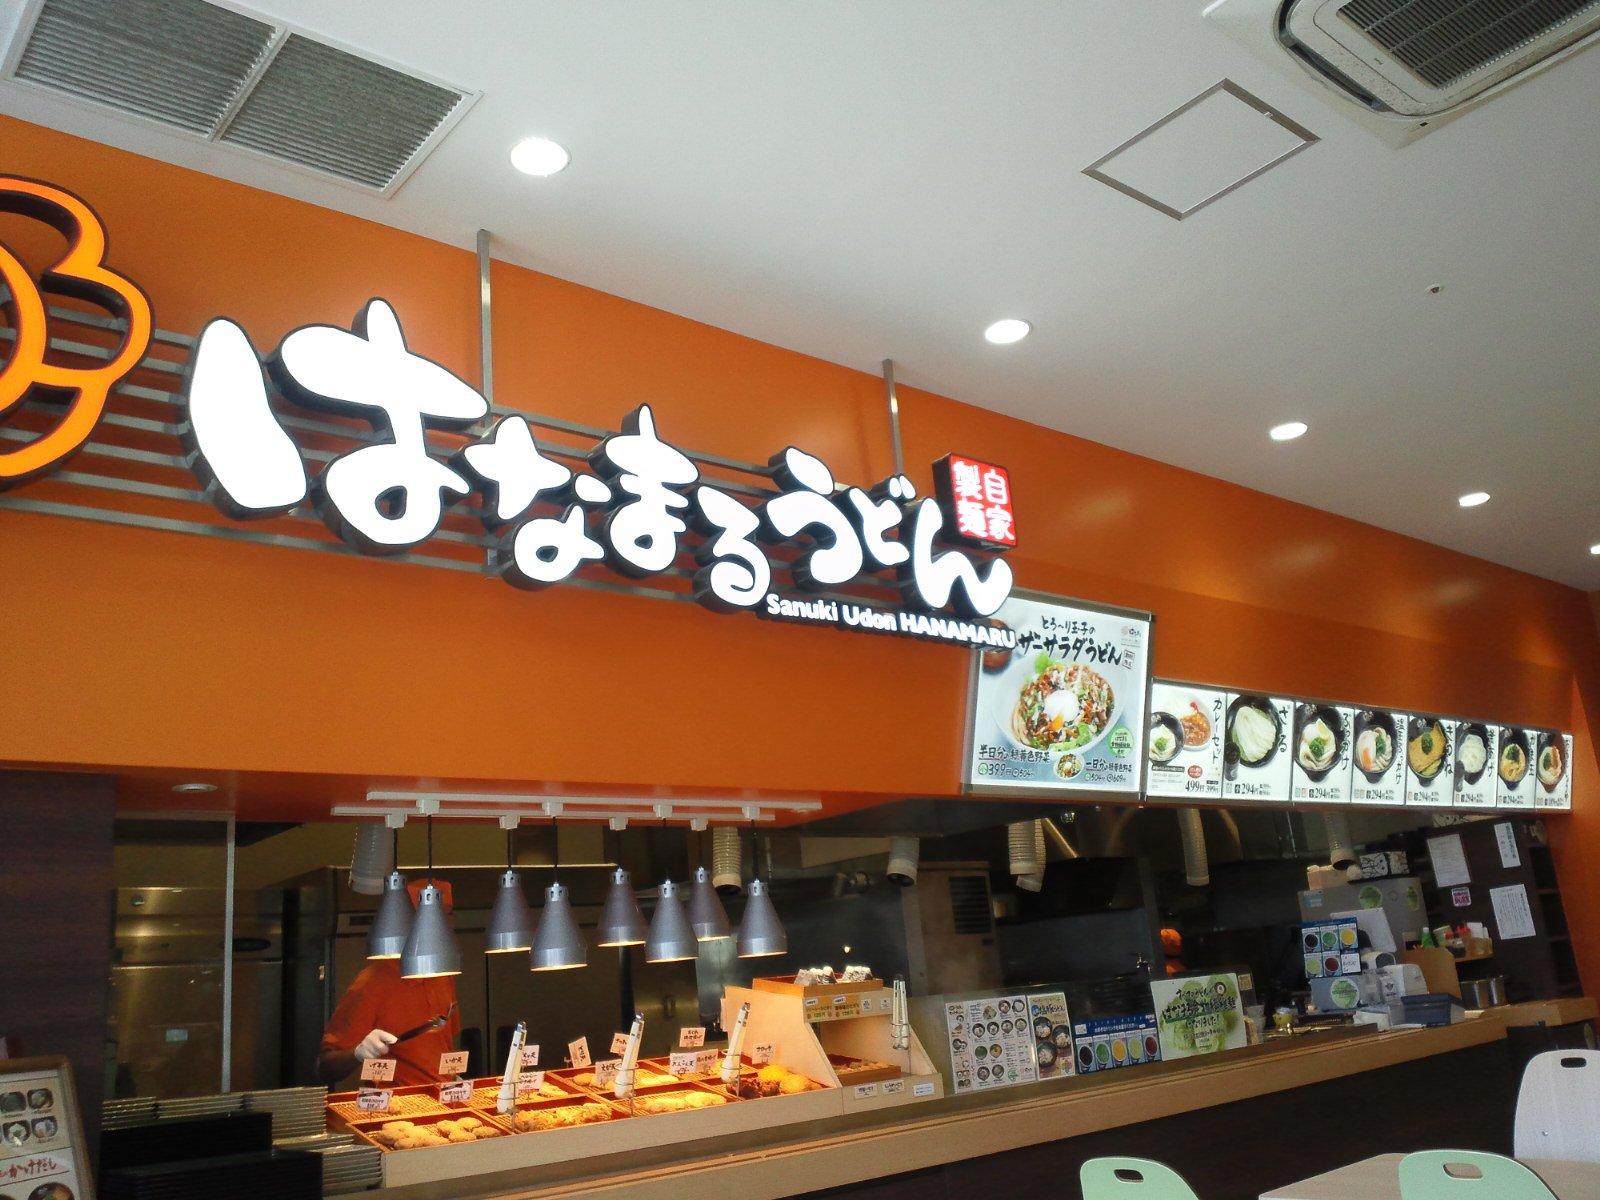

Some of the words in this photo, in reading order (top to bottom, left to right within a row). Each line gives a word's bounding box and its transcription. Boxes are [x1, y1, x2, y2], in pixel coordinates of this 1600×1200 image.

[189, 299, 1013, 617] はなまるうどん
[766, 594, 839, 622] Sanuki
[842, 605, 898, 631] Udon
[900, 612, 1016, 649] HANAMARU
[1212, 699, 1223, 765] カレーセット
[1279, 704, 1291, 753] ざる
